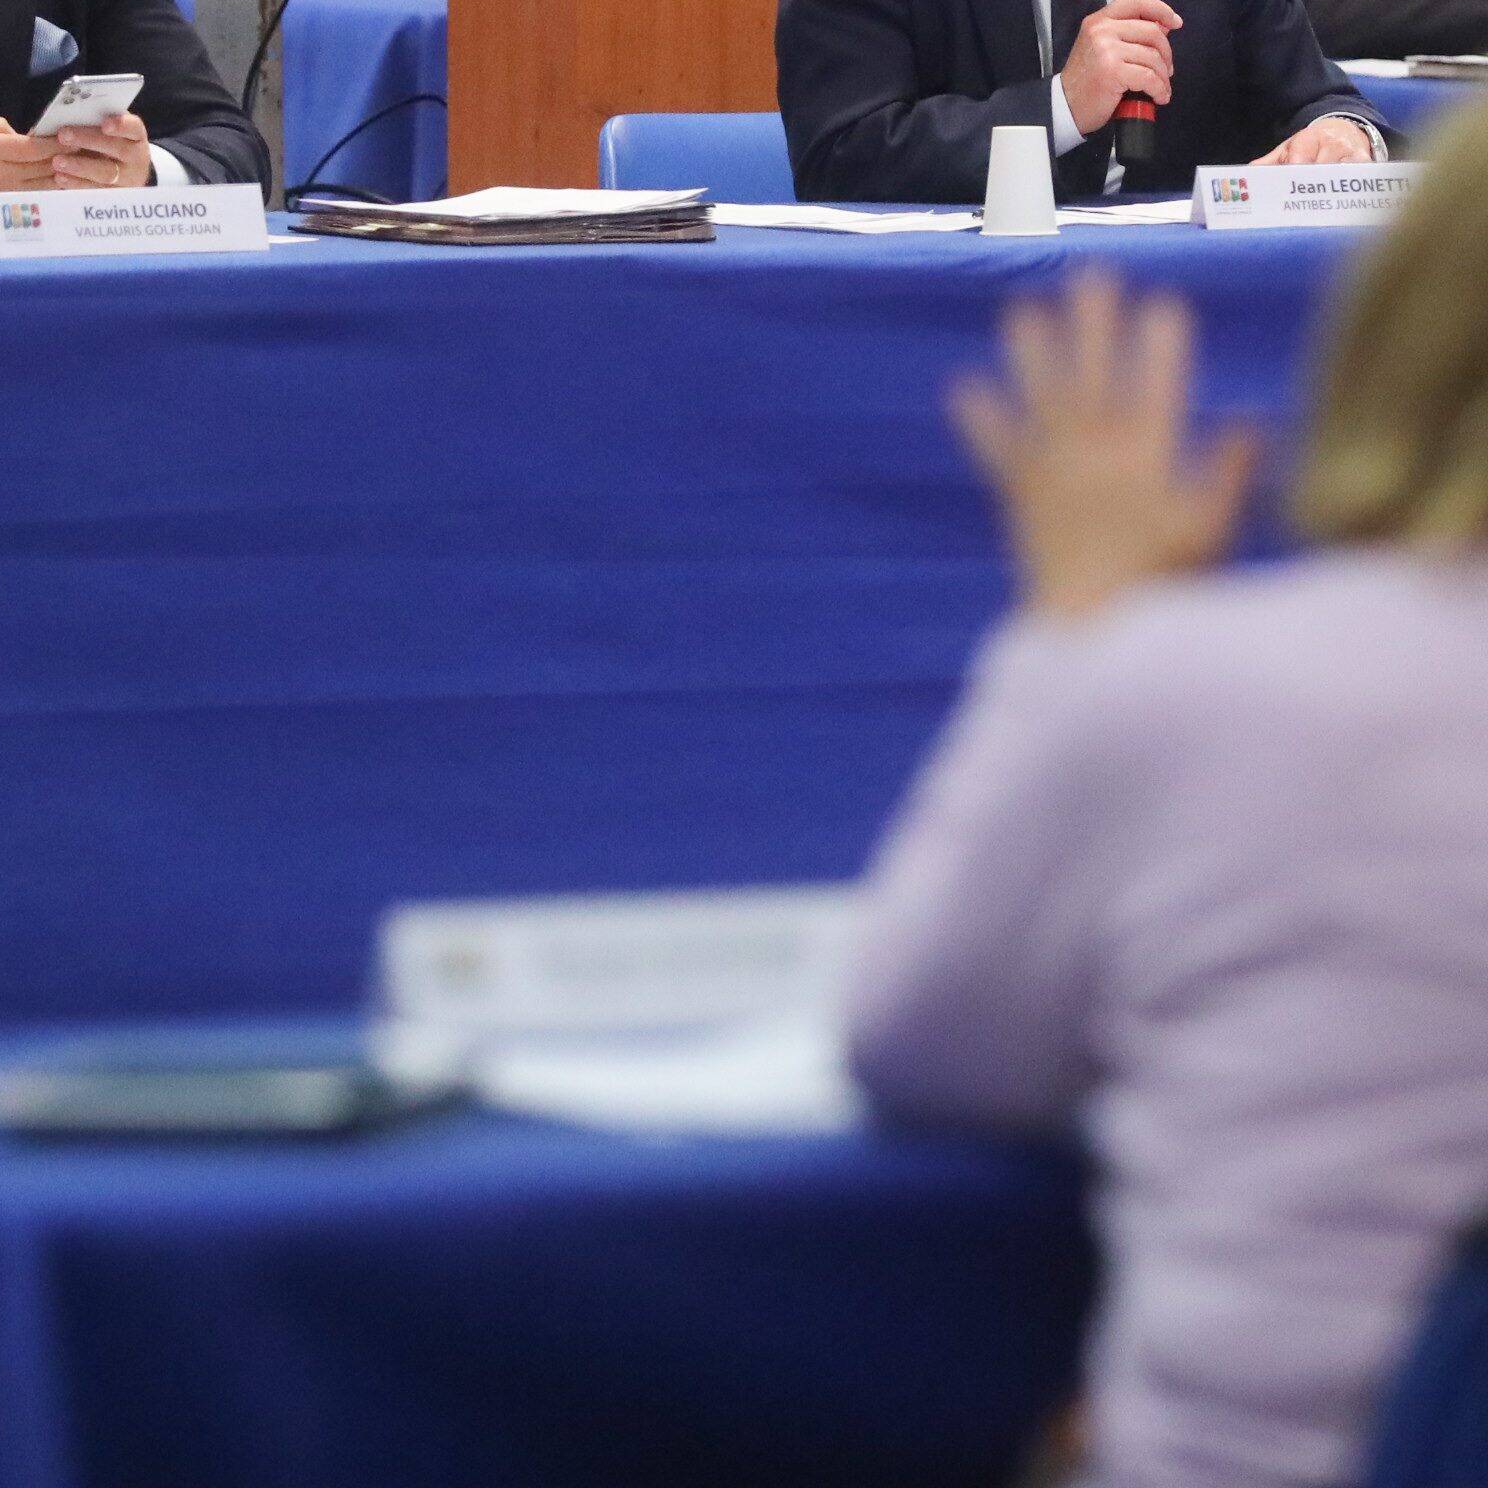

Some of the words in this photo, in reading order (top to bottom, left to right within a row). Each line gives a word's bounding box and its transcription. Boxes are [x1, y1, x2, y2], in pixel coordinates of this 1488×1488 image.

[1289, 180, 1327, 194] Jean
[83, 204, 130, 220] Kevin
[133, 202, 208, 219] LUCIANO
[1283, 199, 1333, 211] ANTIBES
[75, 224, 143, 238] VALLAURIS
[145, 223, 222, 236] GOLFE-JUAN
